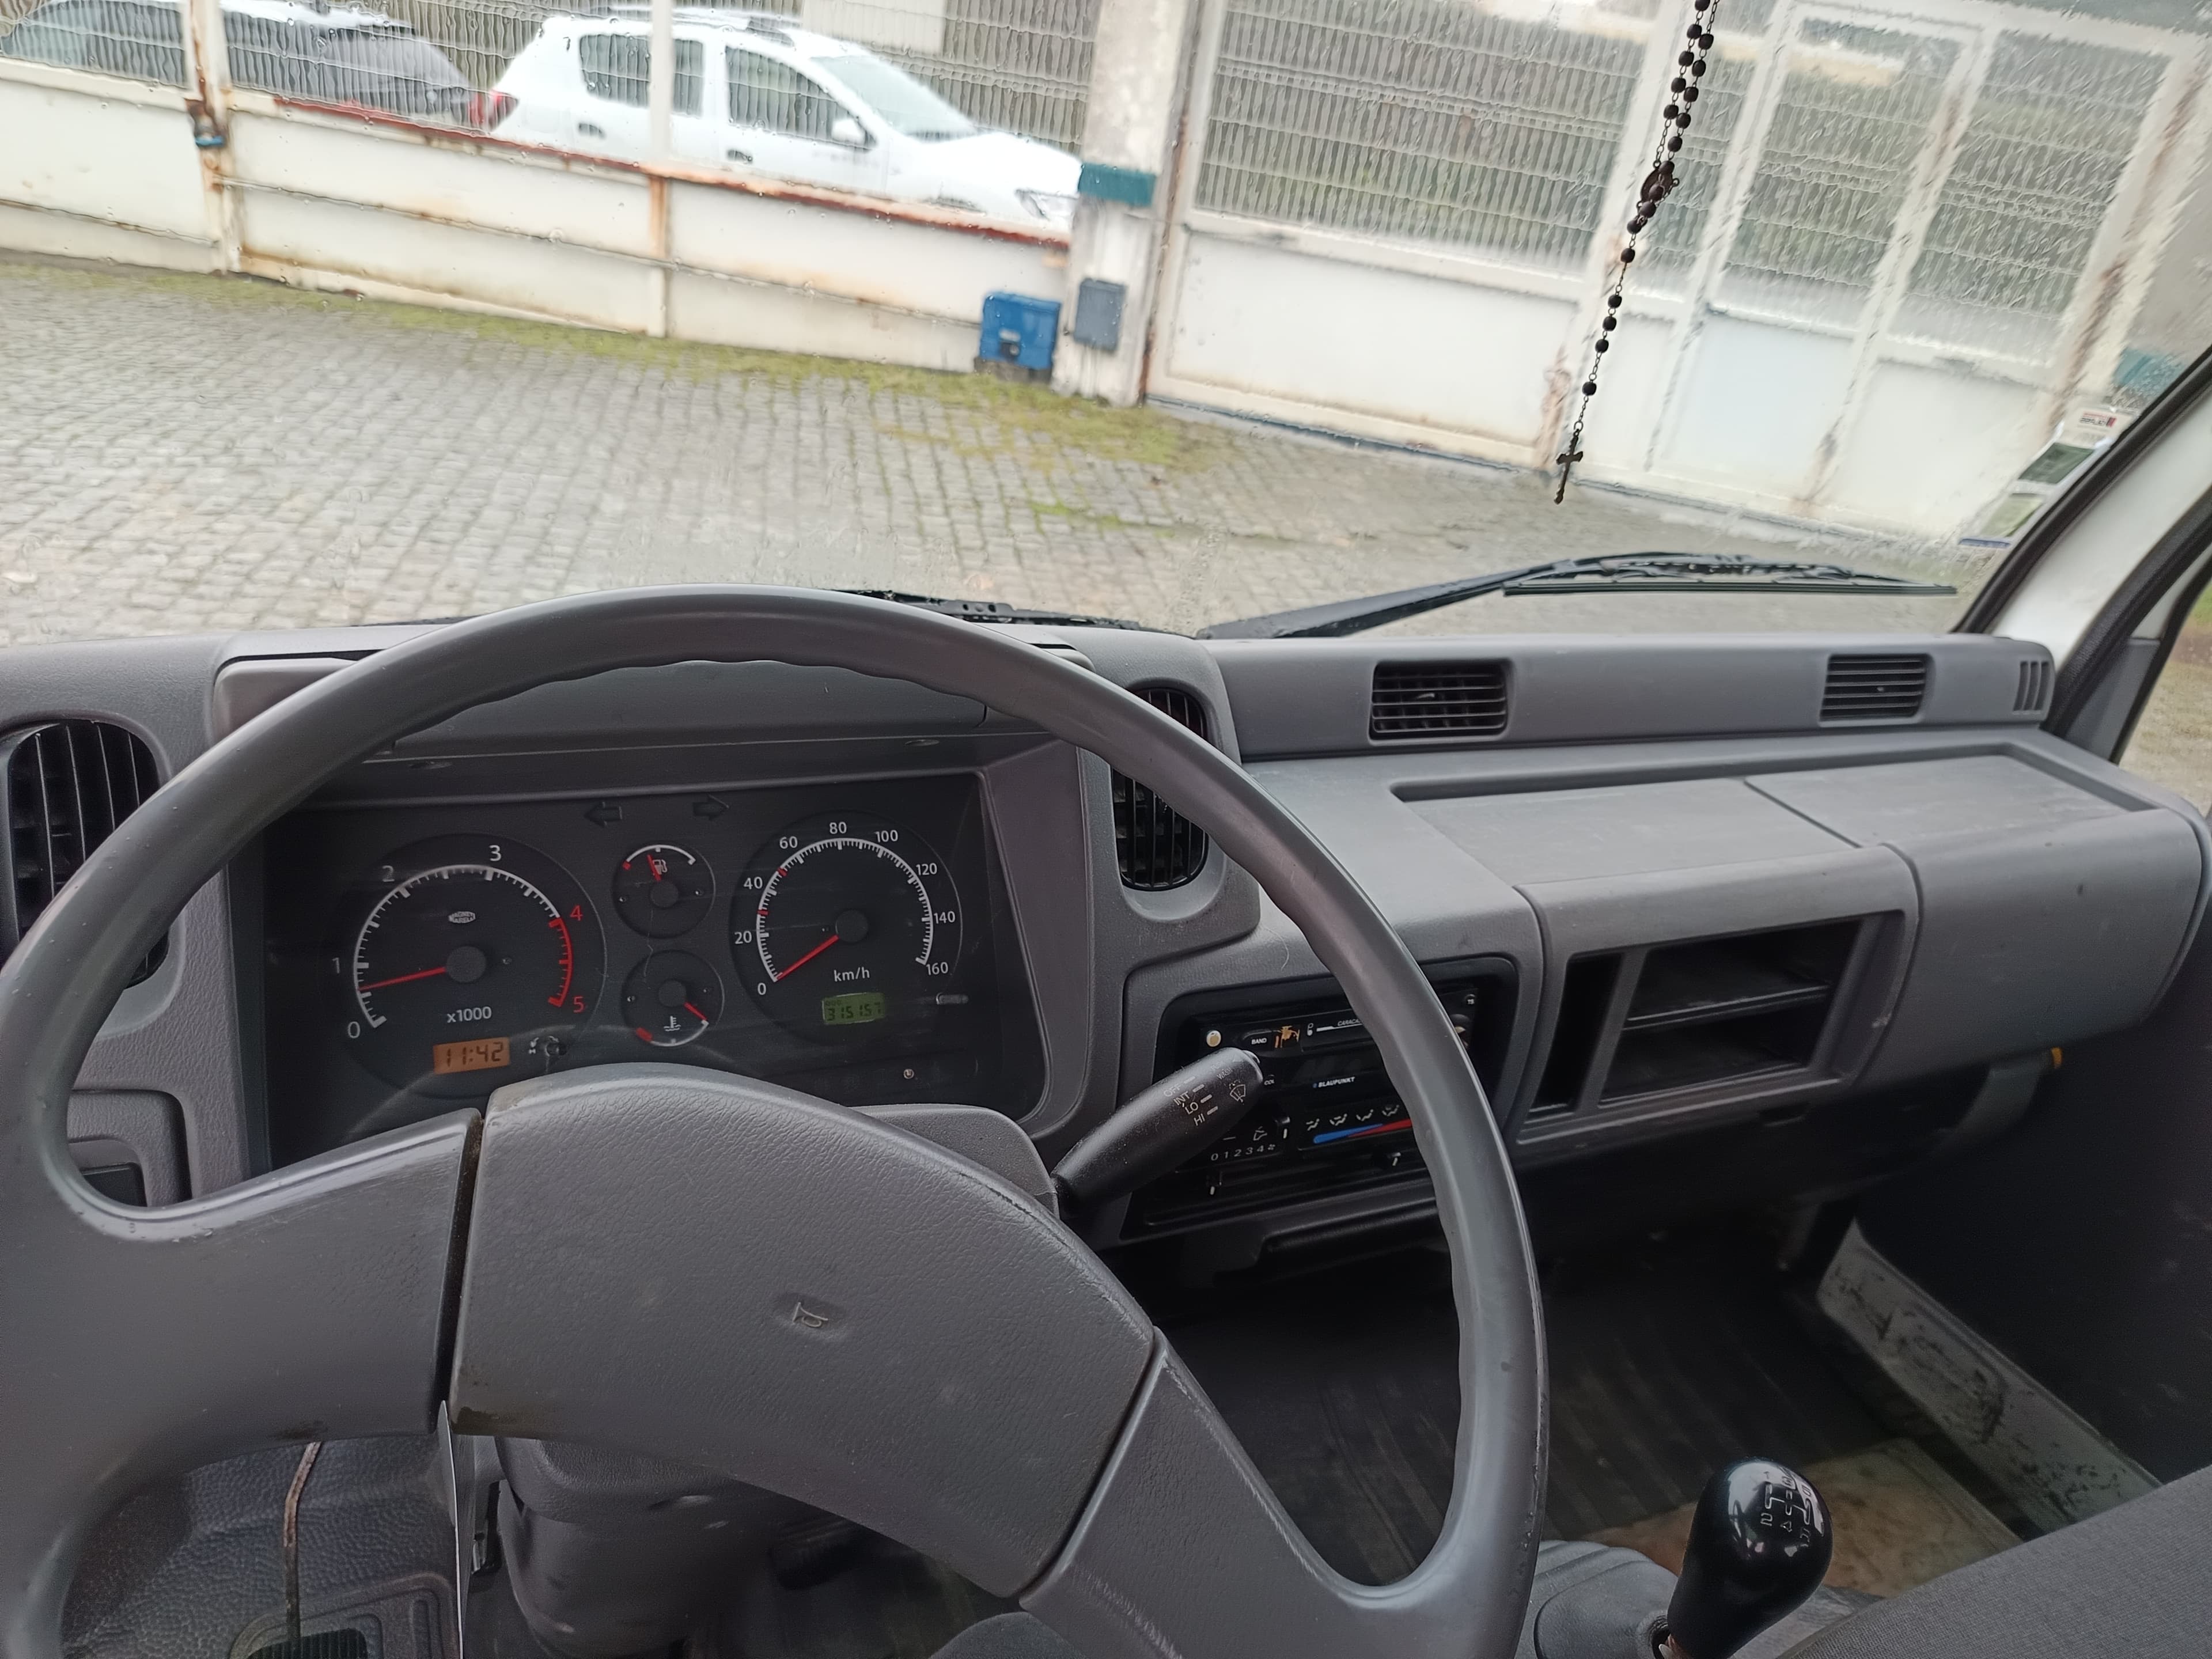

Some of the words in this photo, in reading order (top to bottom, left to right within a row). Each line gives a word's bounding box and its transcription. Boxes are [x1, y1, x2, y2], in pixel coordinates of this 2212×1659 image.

[829, 821, 847, 834] 80
[779, 836, 798, 849] 60
[874, 830, 899, 843] 100
[490, 844, 501, 861] 3
[382, 865, 395, 882] 2
[915, 862, 938, 876] 120
[743, 876, 763, 890] 40
[570, 905, 583, 921] 4
[934, 911, 956, 924] 140
[734, 930, 752, 945] 20
[332, 957, 340, 974] 1
[926, 962, 949, 975] 160
[834, 966, 870, 982] km/h
[757, 983, 767, 995] 0
[573, 997, 584, 1013] 5
[447, 1006, 492, 1023] x1000
[347, 1021, 361, 1039] 0
[446, 1041, 503, 1067] 11:42
[1164, 1083, 1181, 1097] OFF
[1318, 1077, 1355, 1088] BLAUPUNKT
[1173, 1090, 1190, 1106] INT
[1184, 1101, 1199, 1115] LO
[1194, 1113, 1206, 1126] HI
[1210, 1153, 1219, 1161] 0
[1224, 1151, 1229, 1159] 1
[1233, 1149, 1243, 1157] 2
[1245, 1147, 1254, 1156] 3
[1256, 1145, 1264, 1153] 4
[1760, 1512, 1773, 1527] 2
